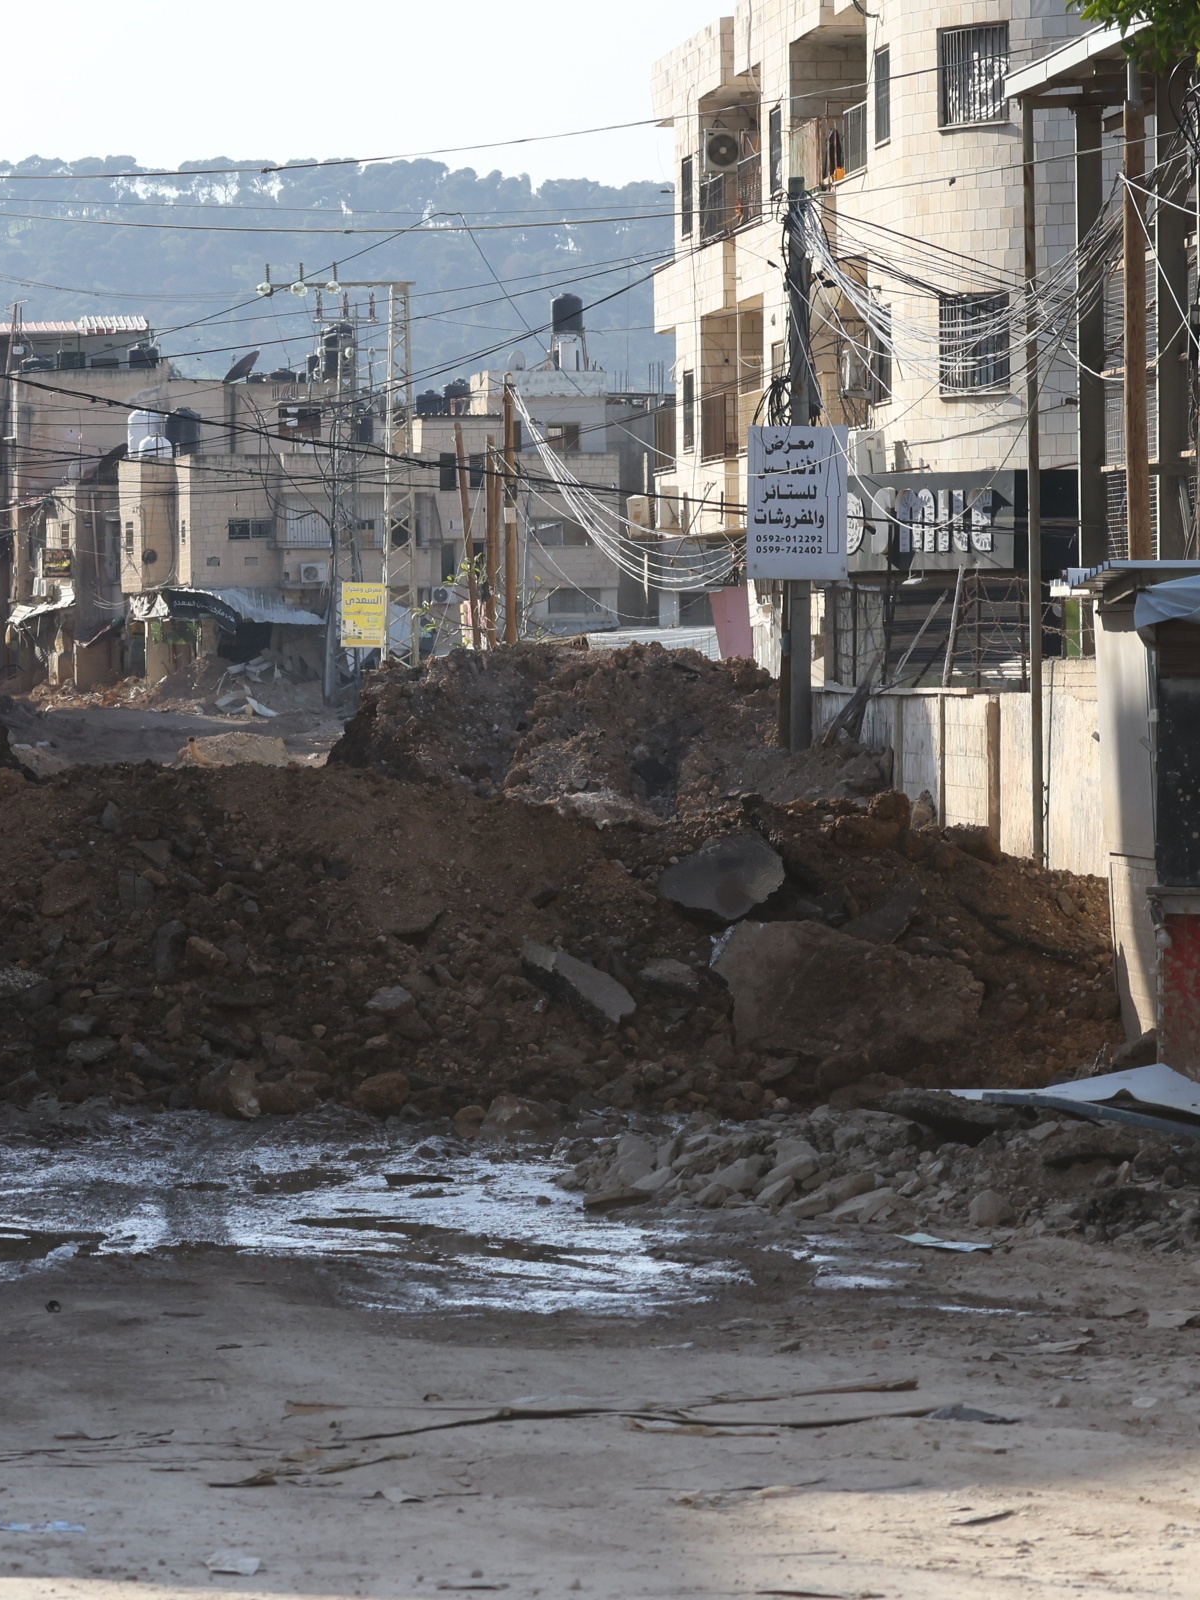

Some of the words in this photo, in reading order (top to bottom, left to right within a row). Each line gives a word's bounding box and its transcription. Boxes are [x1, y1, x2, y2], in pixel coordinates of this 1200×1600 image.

[764, 434, 815, 456] معرض
[757, 455, 822, 480] الأندلس
[761, 480, 818, 504] للستائر
[753, 507, 825, 529] والمفروشات
[756, 534, 823, 544] 0592-012292
[756, 545, 823, 555] 0599-742402
[345, 595, 382, 608] السعدي
